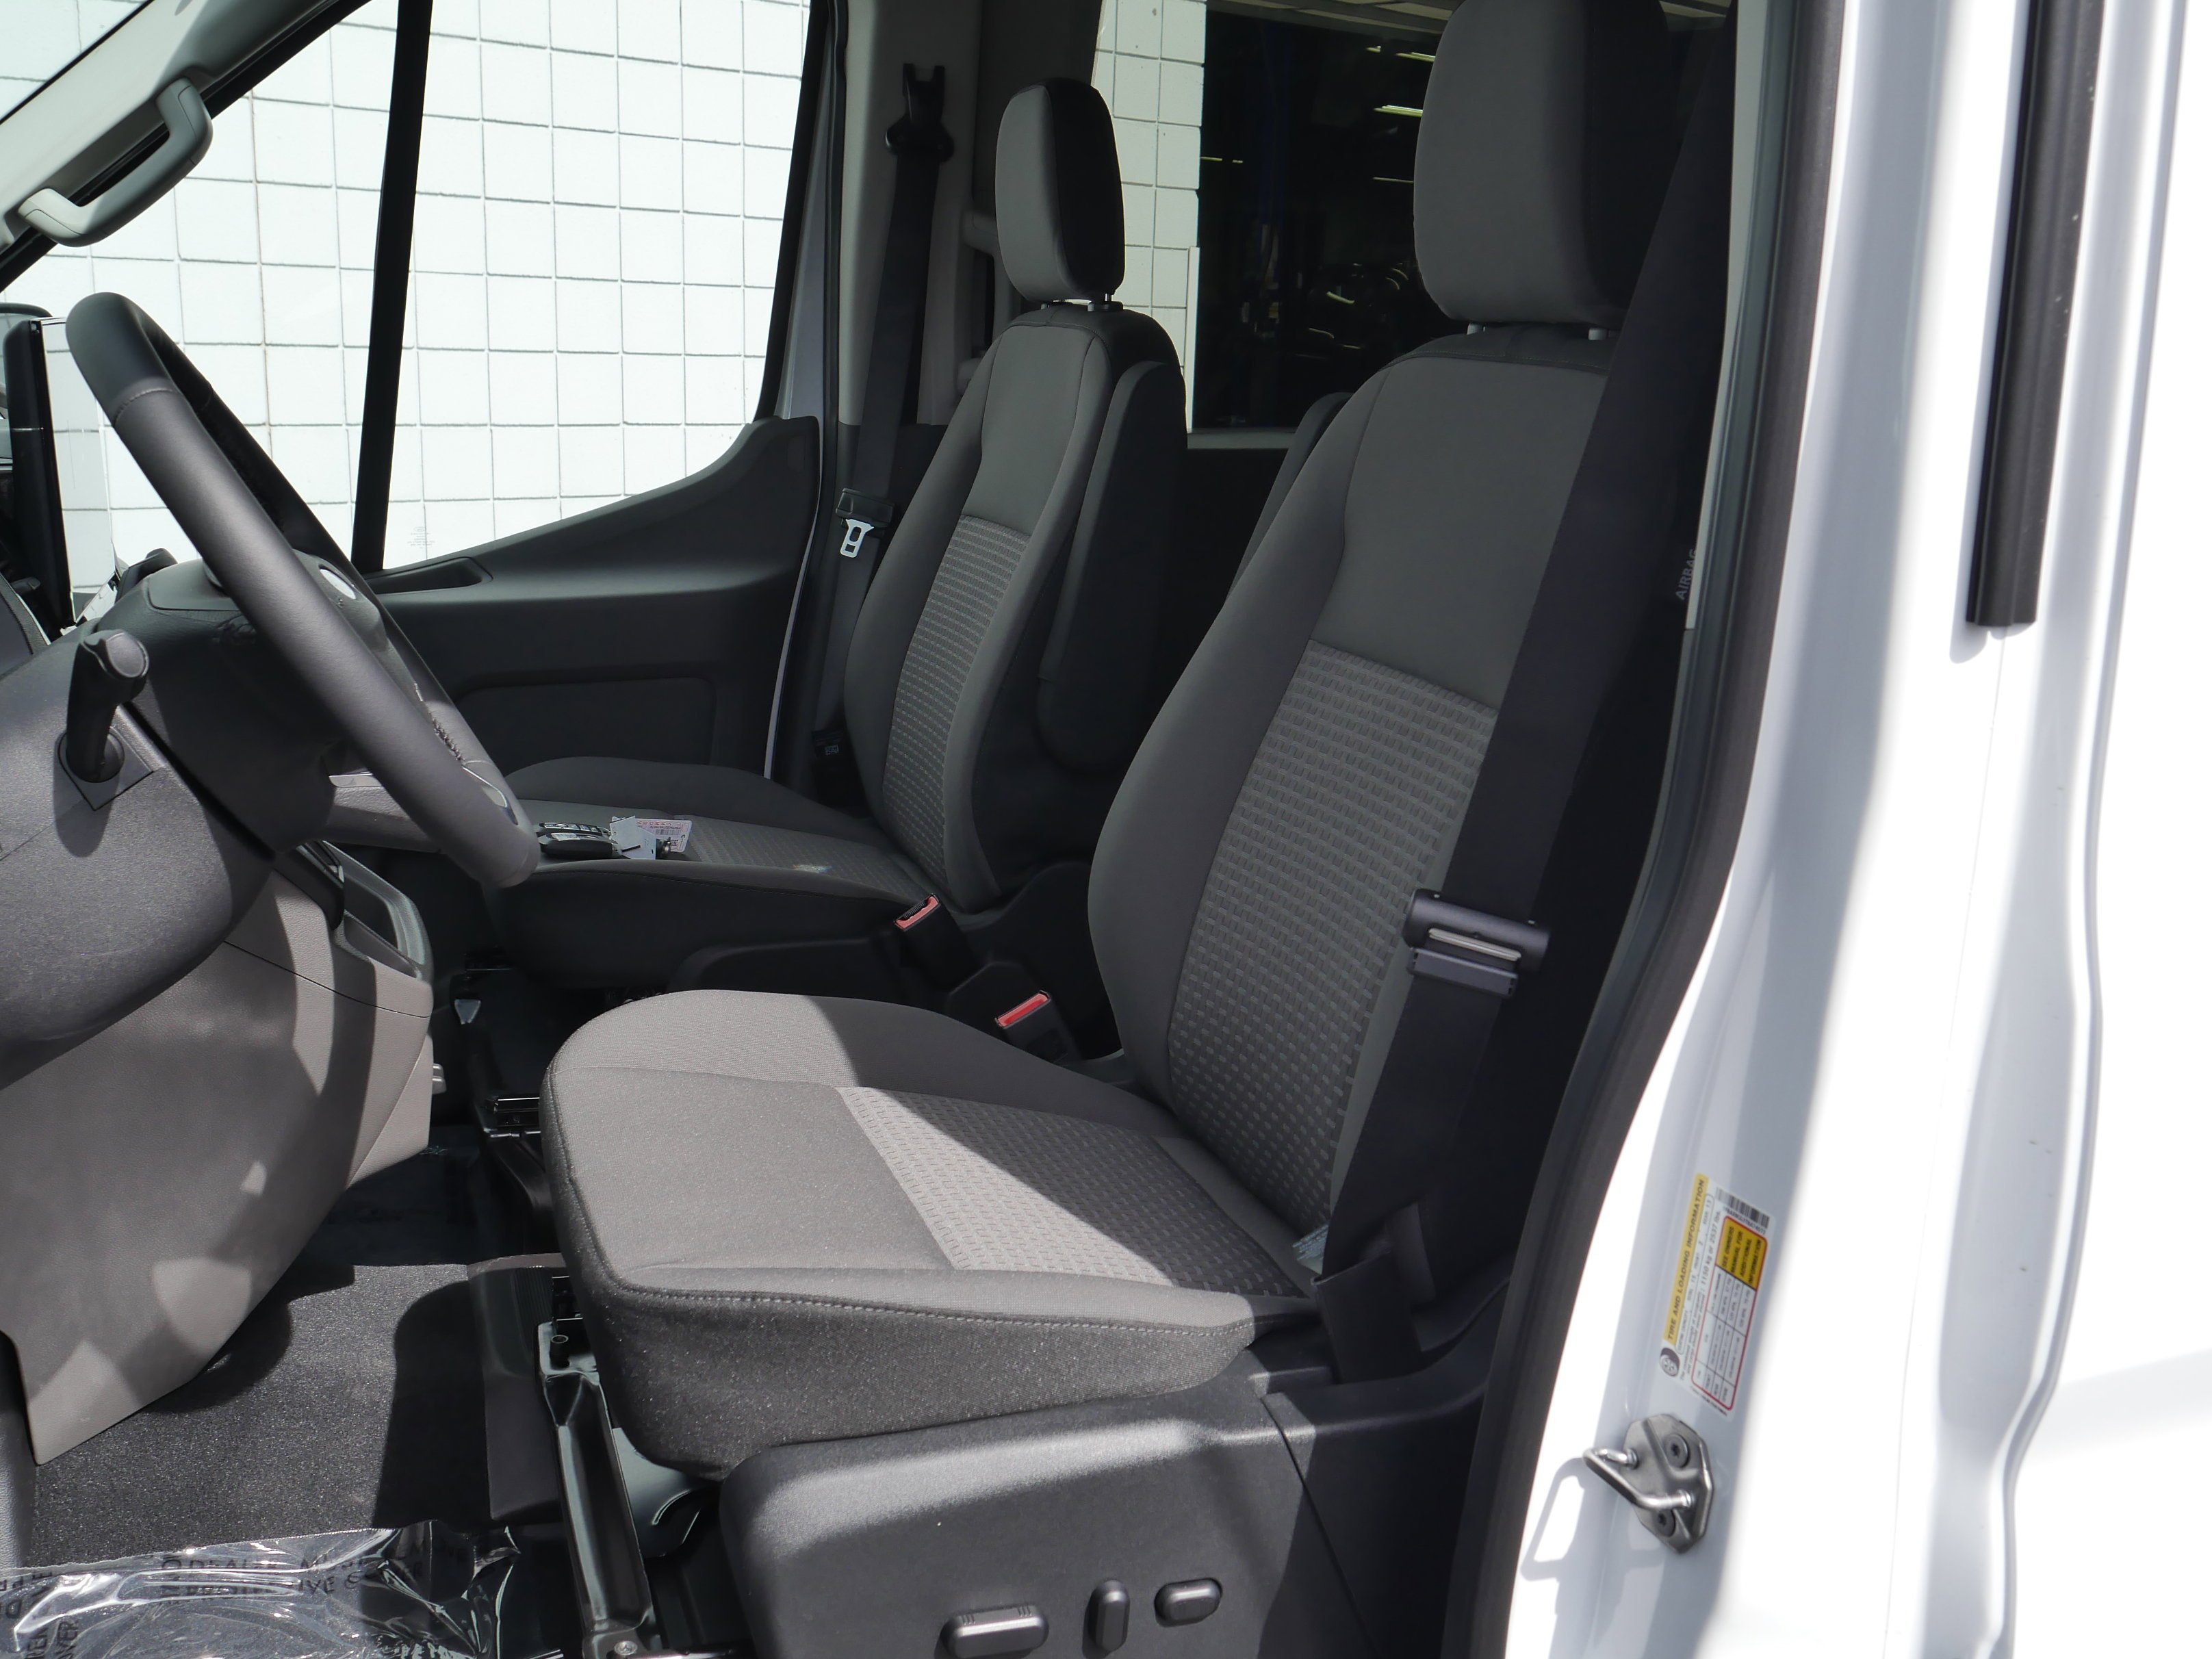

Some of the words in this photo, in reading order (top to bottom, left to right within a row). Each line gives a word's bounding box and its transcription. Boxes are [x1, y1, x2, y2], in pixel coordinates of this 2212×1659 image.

[1667, 1317, 1676, 1341] TIRE
[1672, 1295, 1681, 1315] AND
[1677, 1250, 1690, 1294] LOADING
[1686, 1180, 1704, 1247] INFORMATION
[1701, 1266, 1709, 1285] 1150
[1709, 1224, 1718, 1242] 2537
